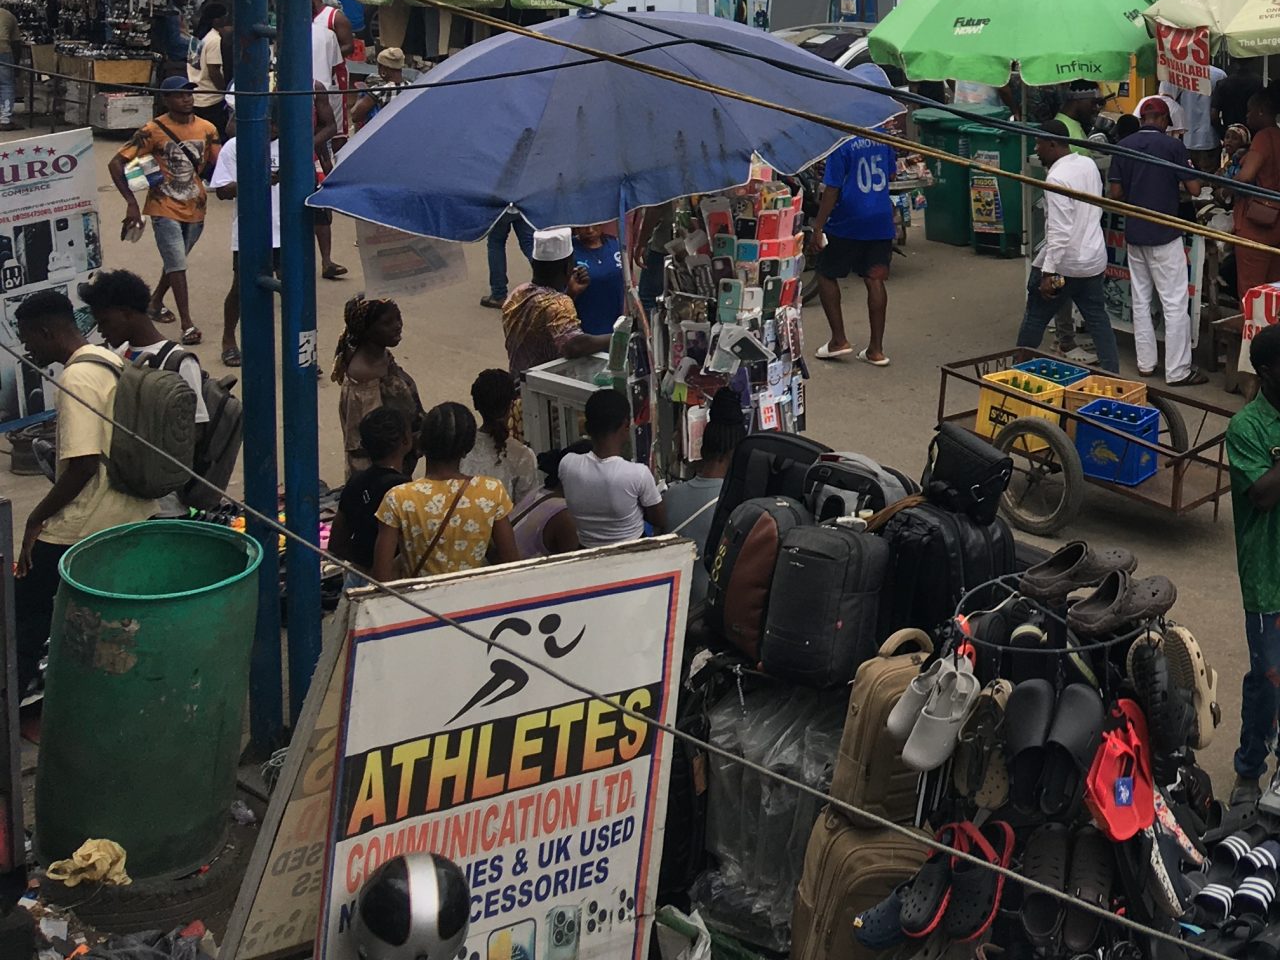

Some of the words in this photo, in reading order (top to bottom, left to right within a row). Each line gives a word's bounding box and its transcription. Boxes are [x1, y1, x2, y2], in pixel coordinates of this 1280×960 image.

[953, 16, 991, 28] Future
[1157, 24, 1210, 63] POS
[1239, 38, 1256, 47] The
[1056, 60, 1102, 75] Infinix
[1168, 72, 1200, 92] HERE
[2, 184, 51, 198] COMMERCE
[856, 155, 887, 194] 05
[346, 688, 652, 836] ATHLETES
[345, 782, 582, 895] COMMUNICATION
[587, 769, 637, 824] LTD.
[511, 847, 529, 877] &
[538, 834, 574, 869] UK
[579, 815, 636, 857] USED
[470, 856, 610, 924] CESSORIES
